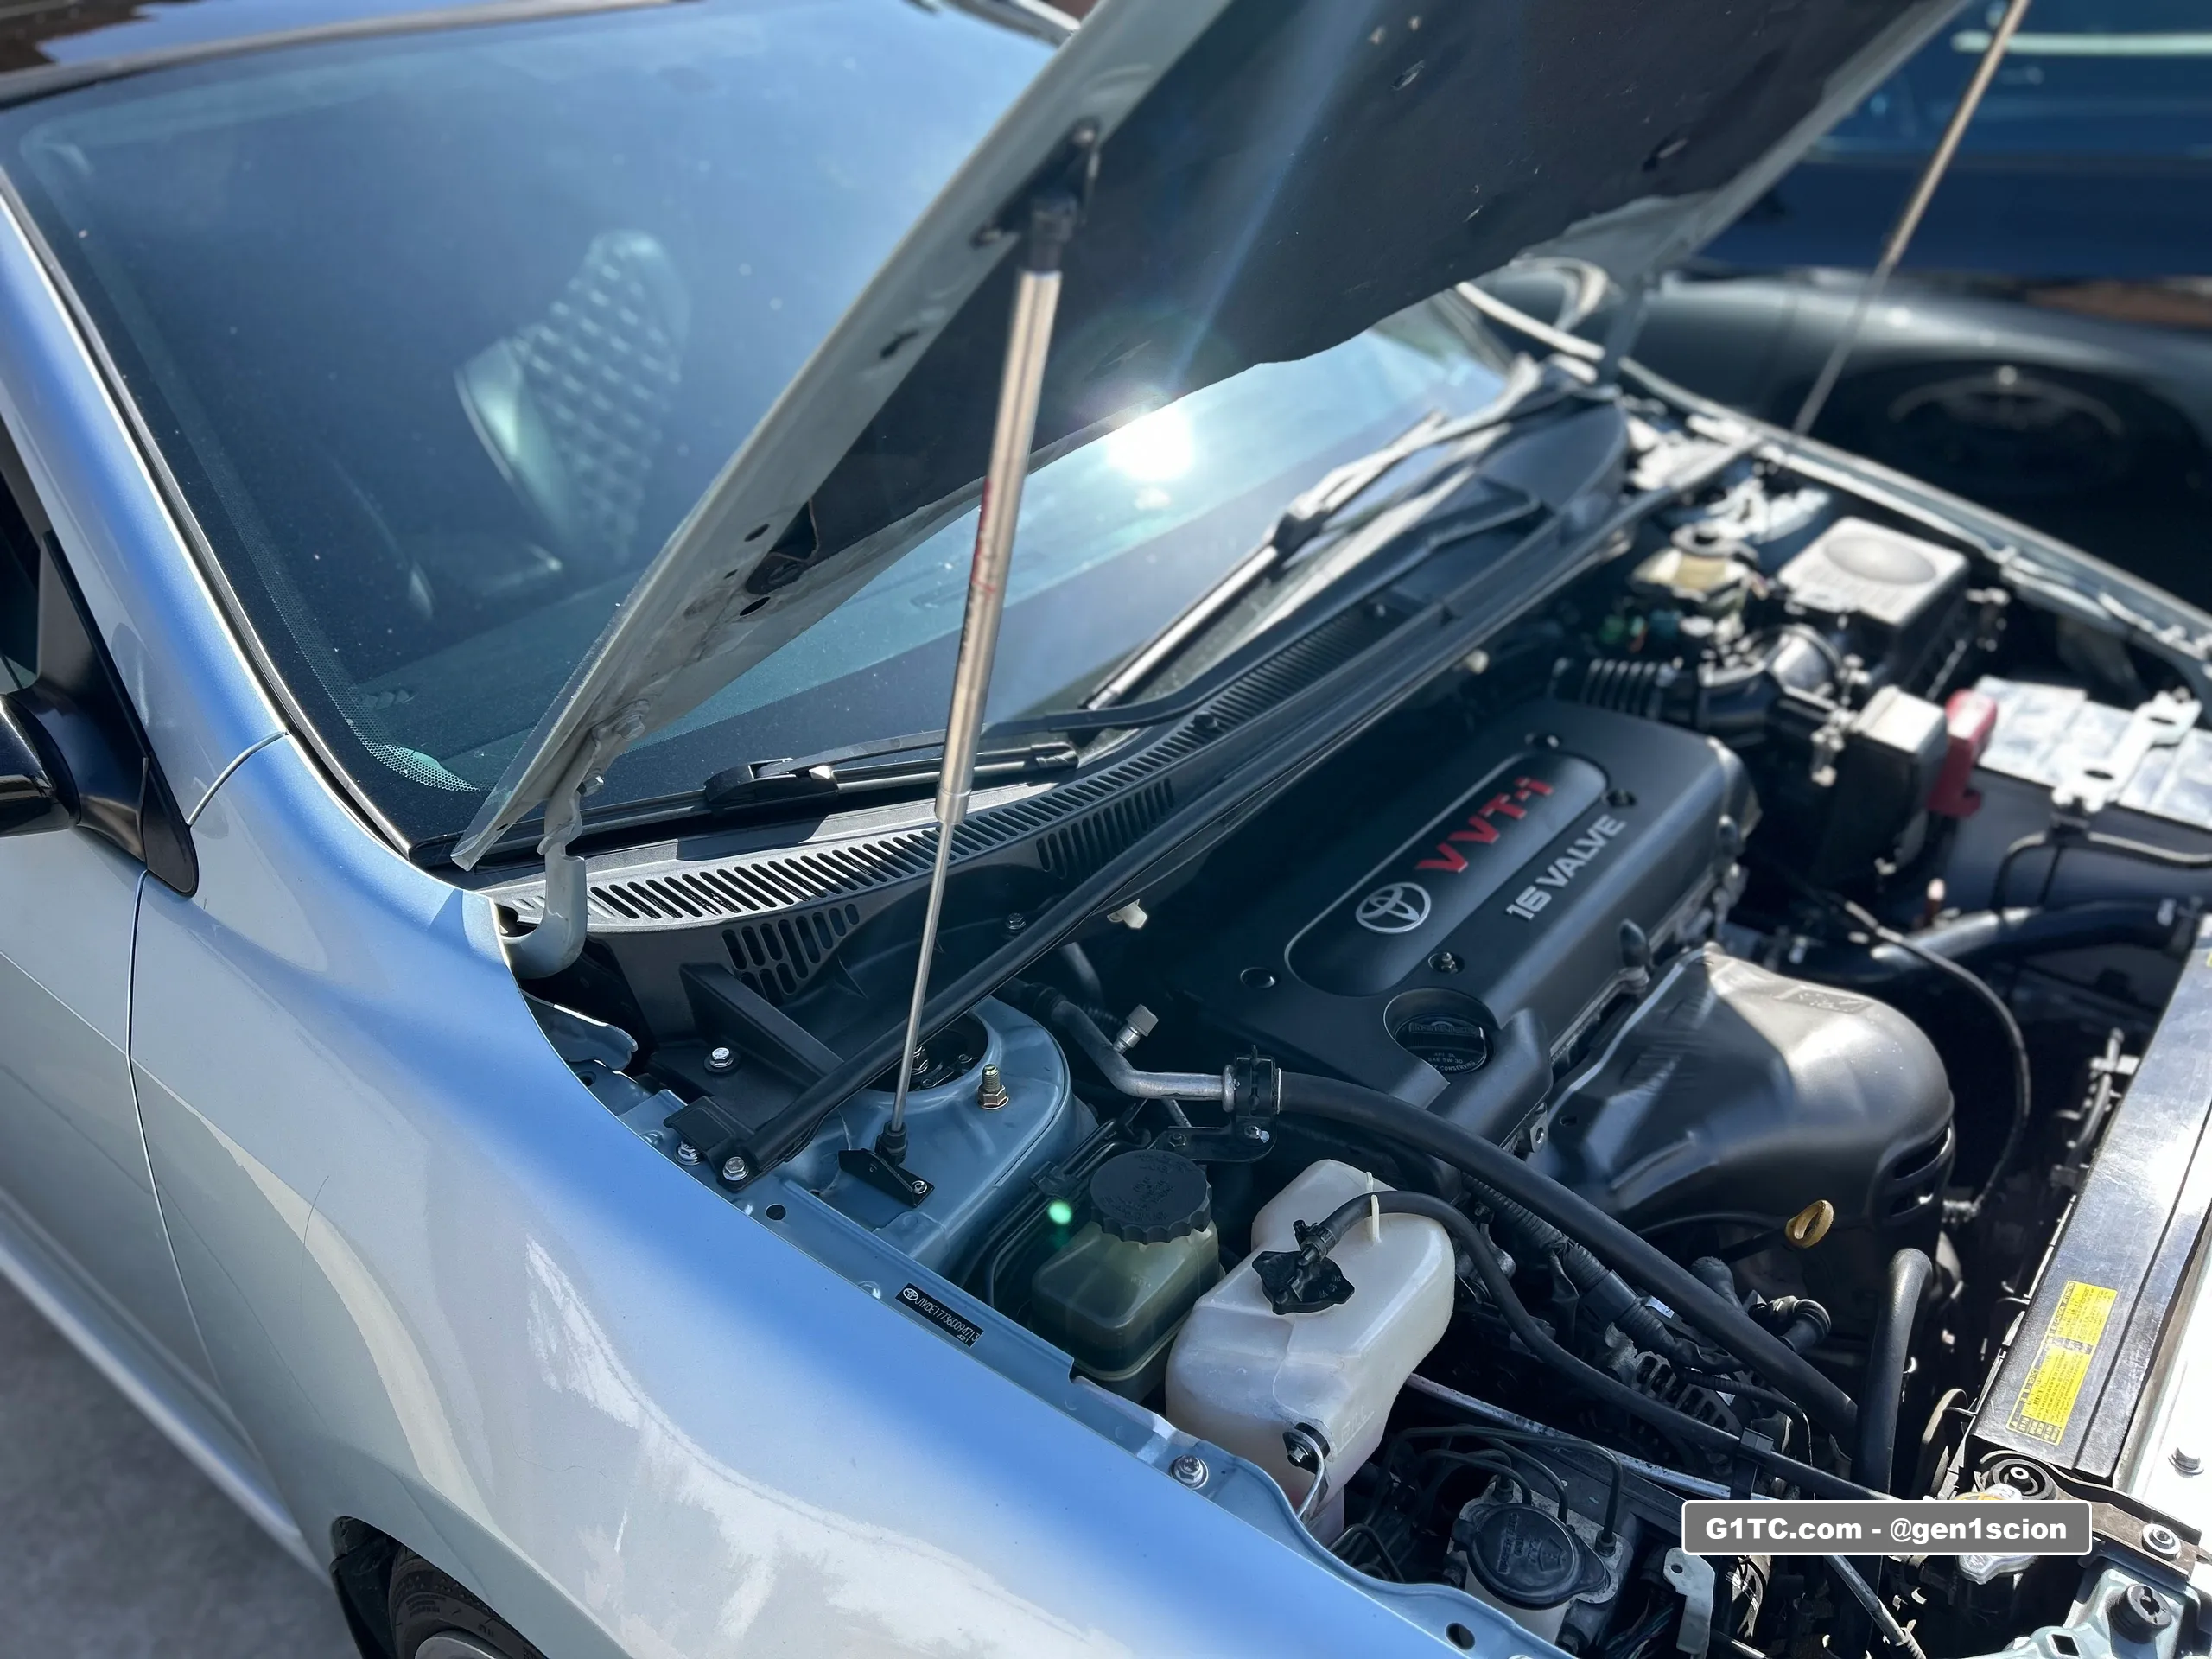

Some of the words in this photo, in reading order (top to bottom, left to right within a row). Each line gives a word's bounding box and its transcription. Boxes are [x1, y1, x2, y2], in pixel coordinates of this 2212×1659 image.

[1415, 777, 1554, 874] VVT-i
[1505, 886, 1552, 920] 16
[1535, 815, 1626, 888] VALVE
